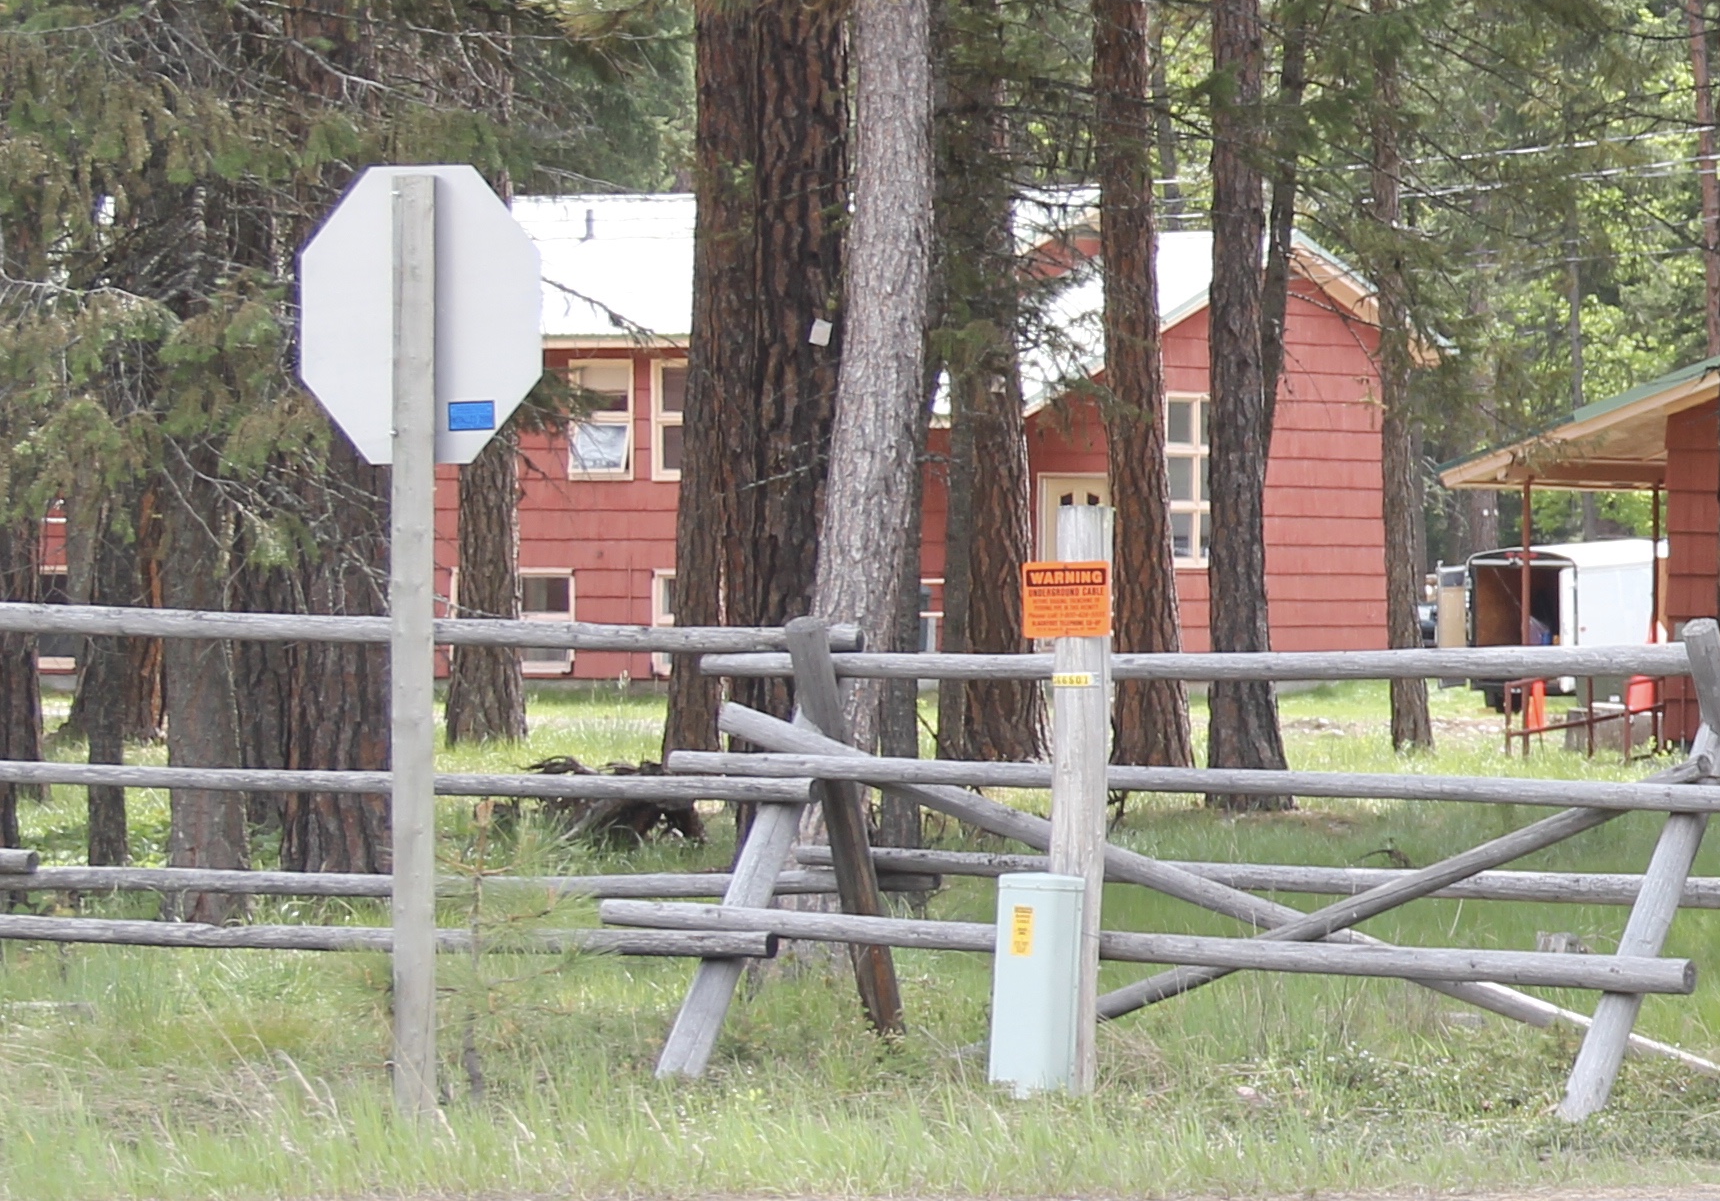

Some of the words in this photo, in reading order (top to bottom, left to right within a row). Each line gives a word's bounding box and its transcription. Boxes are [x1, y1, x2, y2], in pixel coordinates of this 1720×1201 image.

[1030, 570, 1103, 585] WARNING
[1028, 588, 1080, 597] UNDERGROUND
[1082, 587, 1104, 596] CABLE
